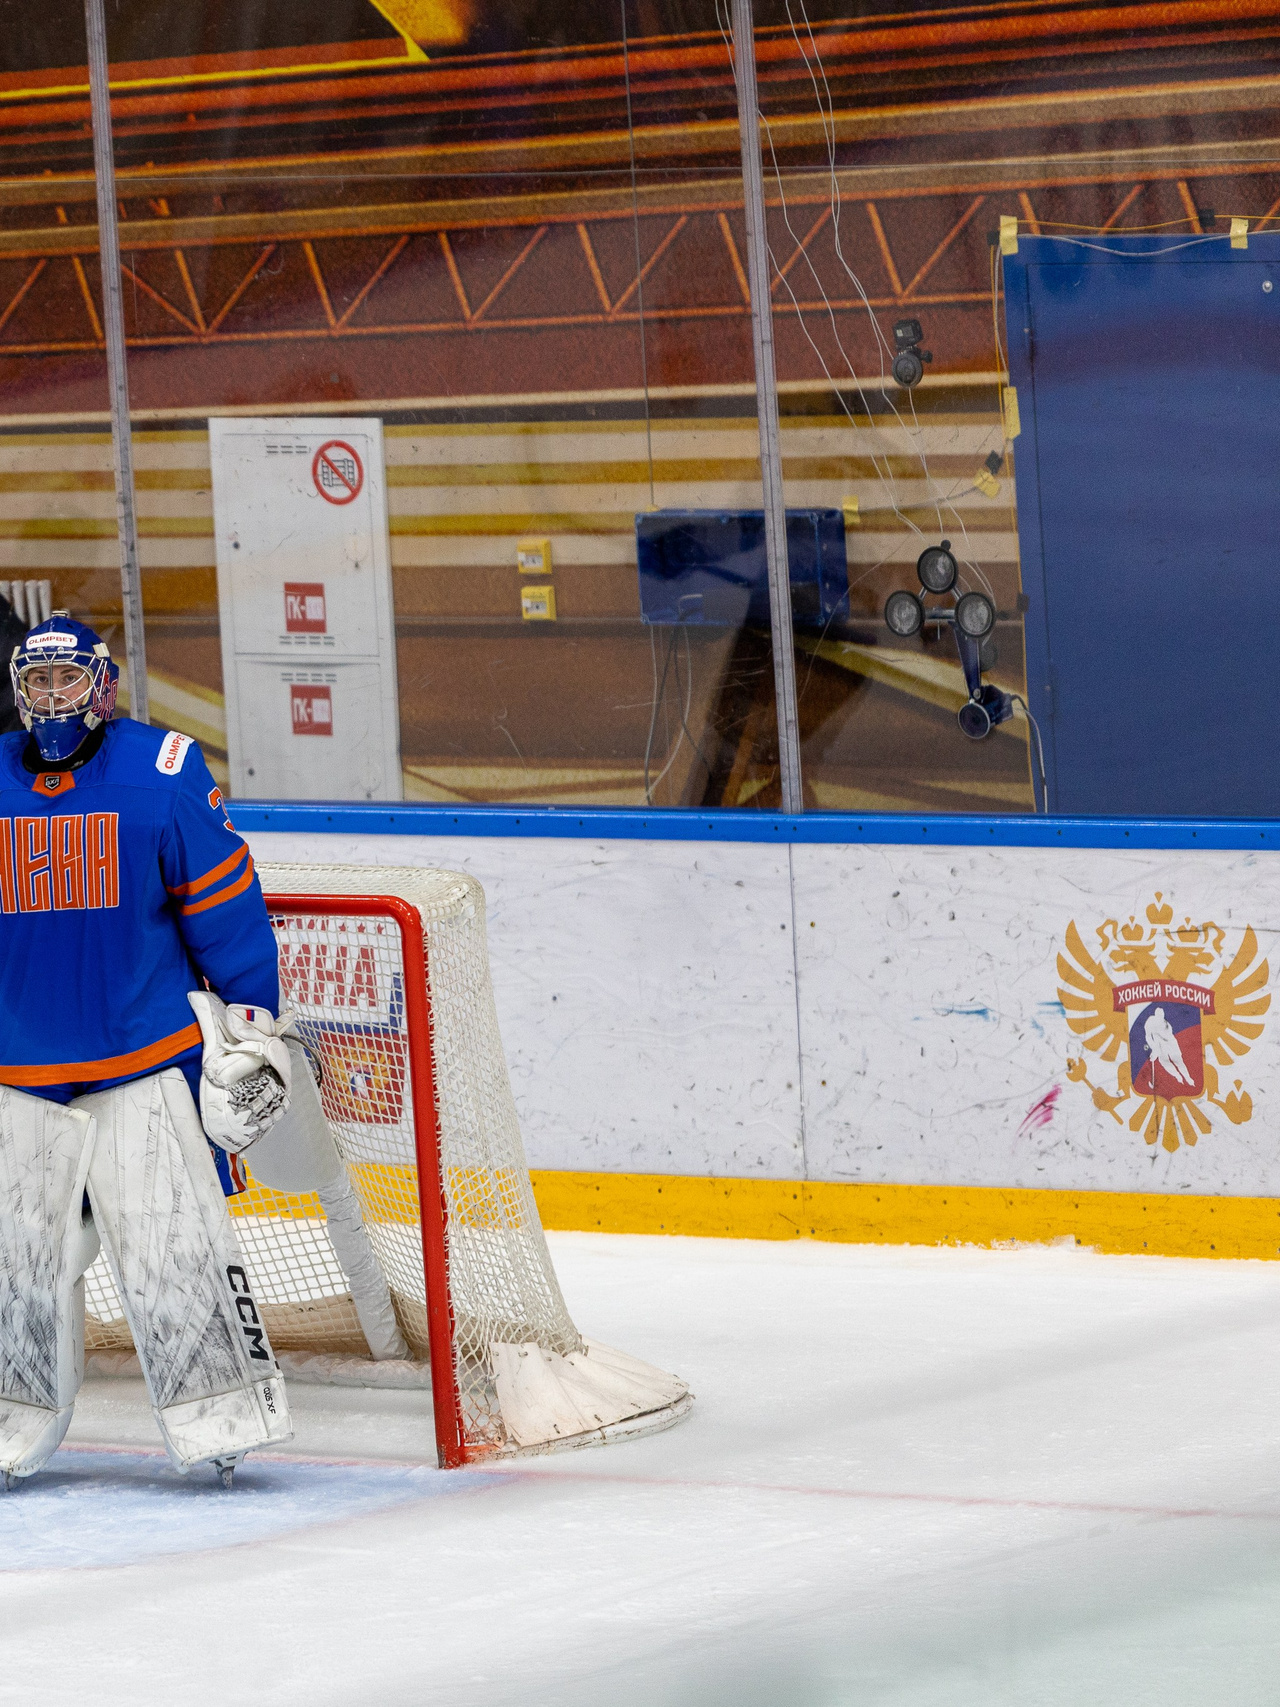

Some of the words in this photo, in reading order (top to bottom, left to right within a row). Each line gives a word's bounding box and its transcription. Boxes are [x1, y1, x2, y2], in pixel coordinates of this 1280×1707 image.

[28, 635, 75, 645] OLIMPBET
[1118, 981, 1162, 1004] ХОККЕЙ
[1165, 984, 1211, 1008] РОССИИ
[226, 1265, 270, 1361] CCM
